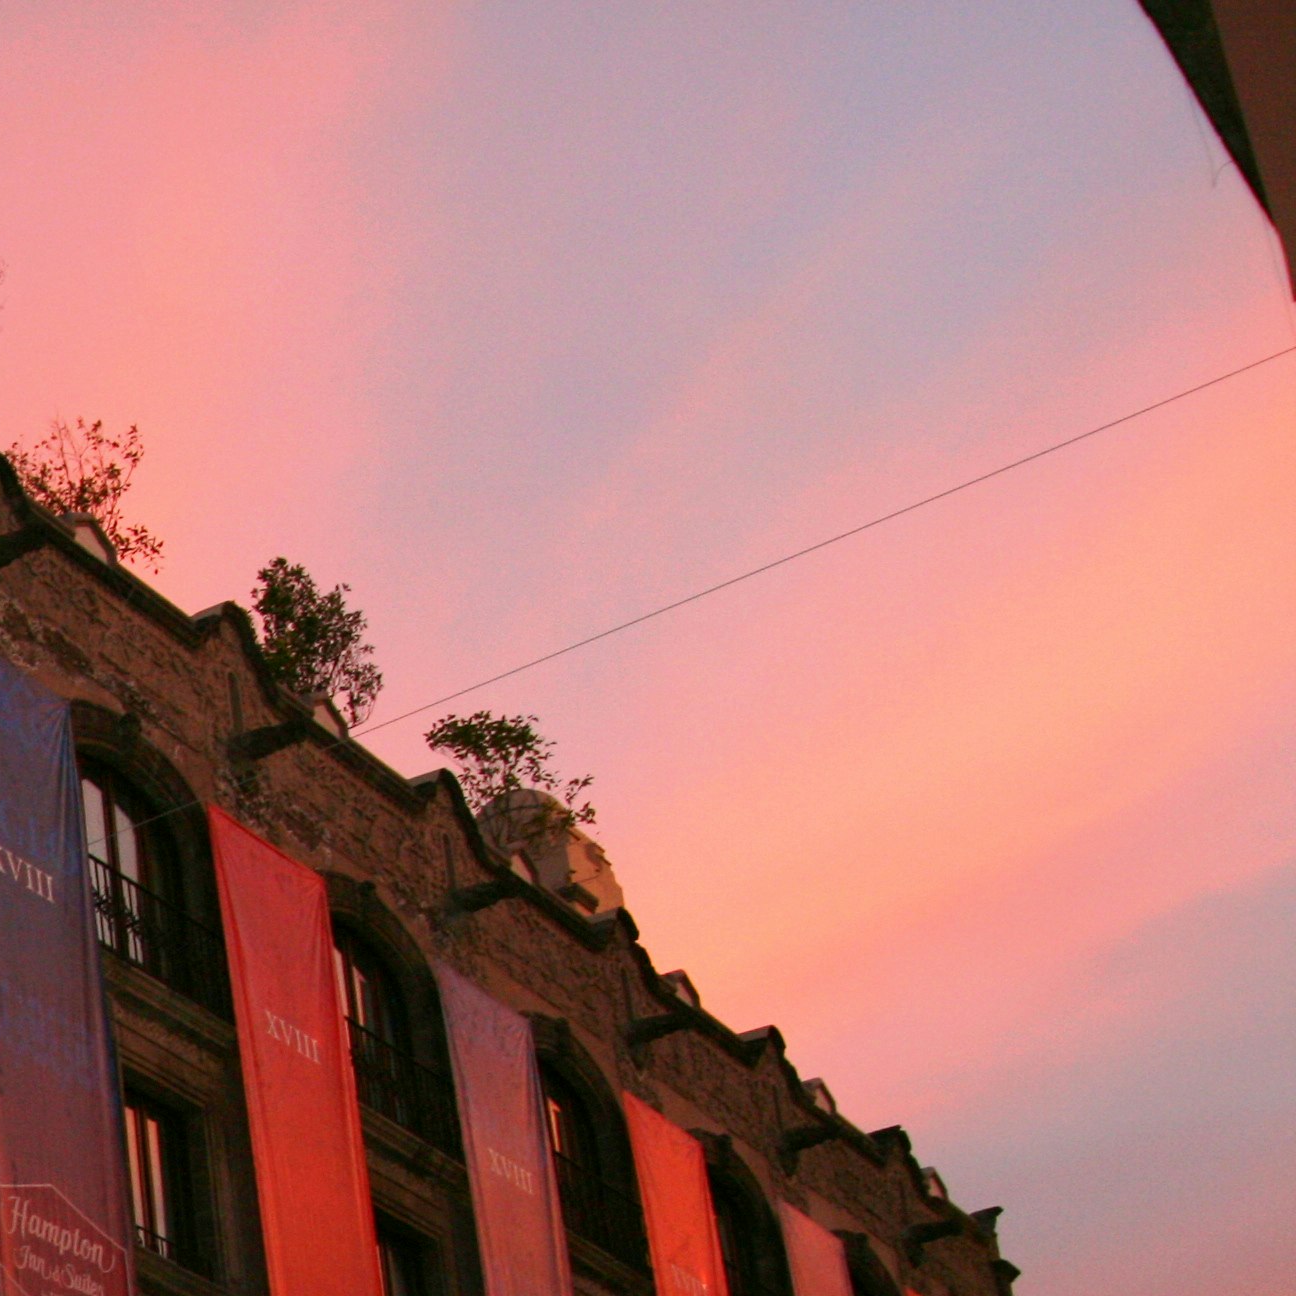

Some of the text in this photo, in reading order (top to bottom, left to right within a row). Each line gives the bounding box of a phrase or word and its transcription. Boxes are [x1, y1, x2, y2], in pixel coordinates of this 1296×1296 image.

[265, 1009, 320, 1065] XVIII
[488, 1147, 534, 1196] XVIII
[8, 1196, 116, 1273] Hampton
[12, 1245, 53, 1280] Inn
